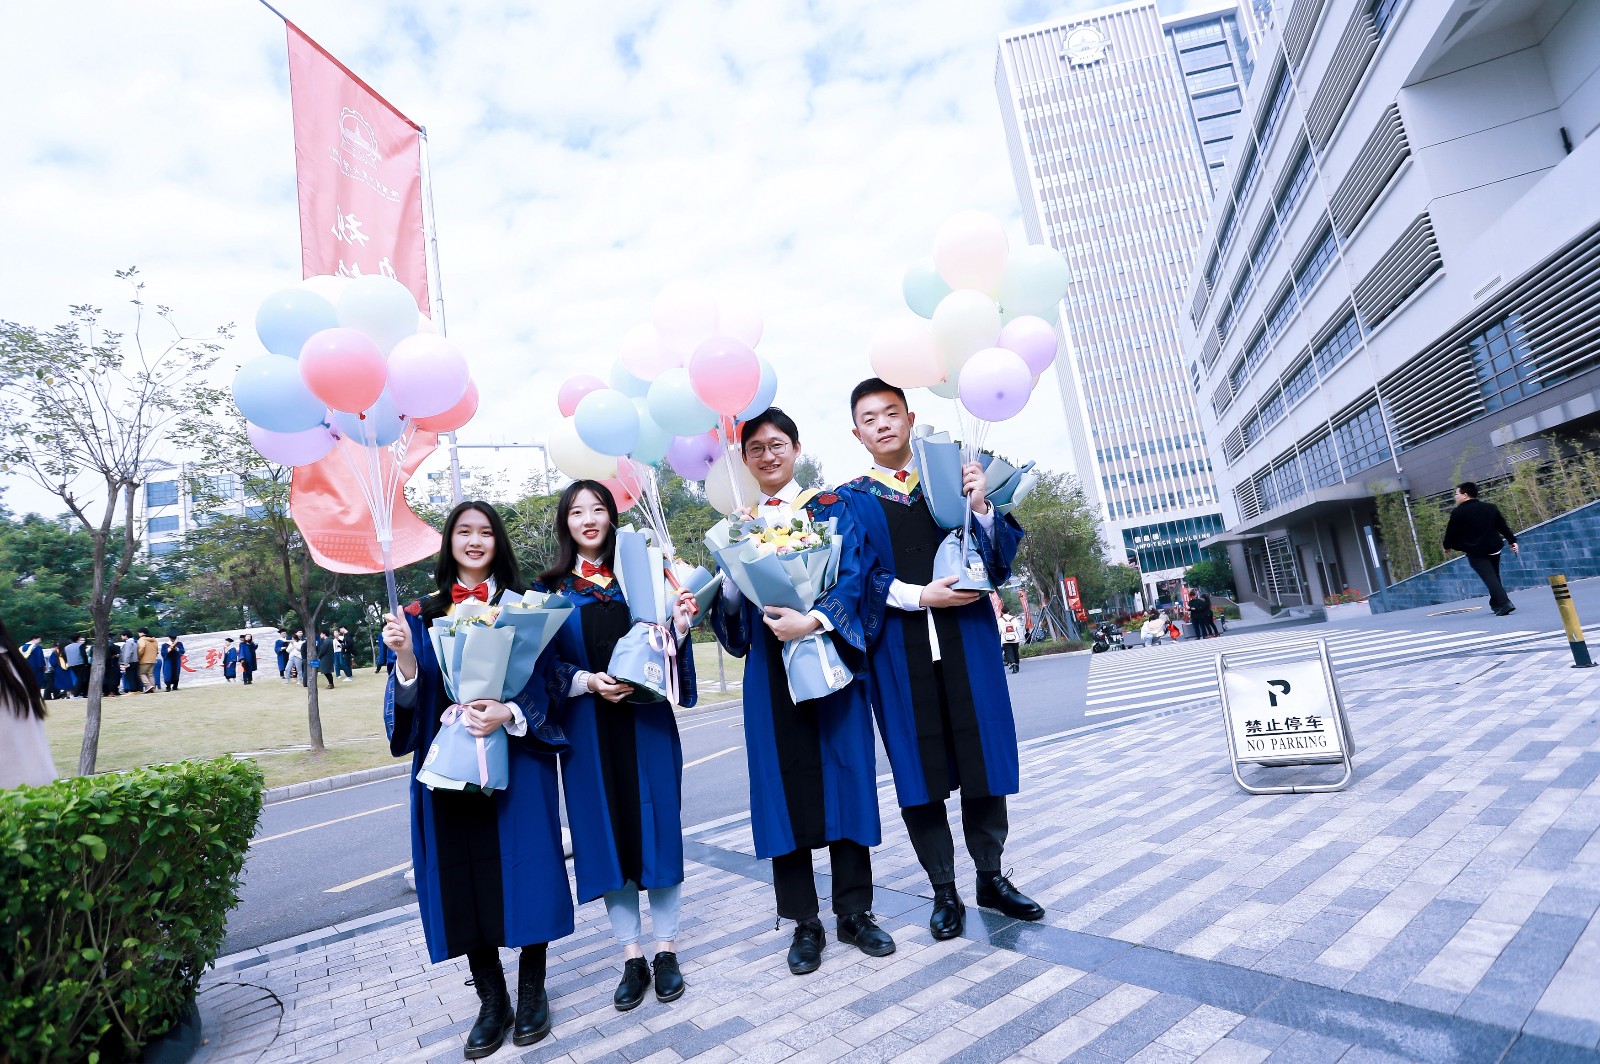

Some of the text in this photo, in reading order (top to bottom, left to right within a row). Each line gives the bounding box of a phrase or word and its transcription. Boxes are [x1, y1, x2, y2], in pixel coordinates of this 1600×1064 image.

[1175, 532, 1211, 544] BUILDING
[1266, 679, 1292, 707] P
[1245, 715, 1324, 734] 禁止停车
[1246, 735, 1328, 752] NO PARKING
